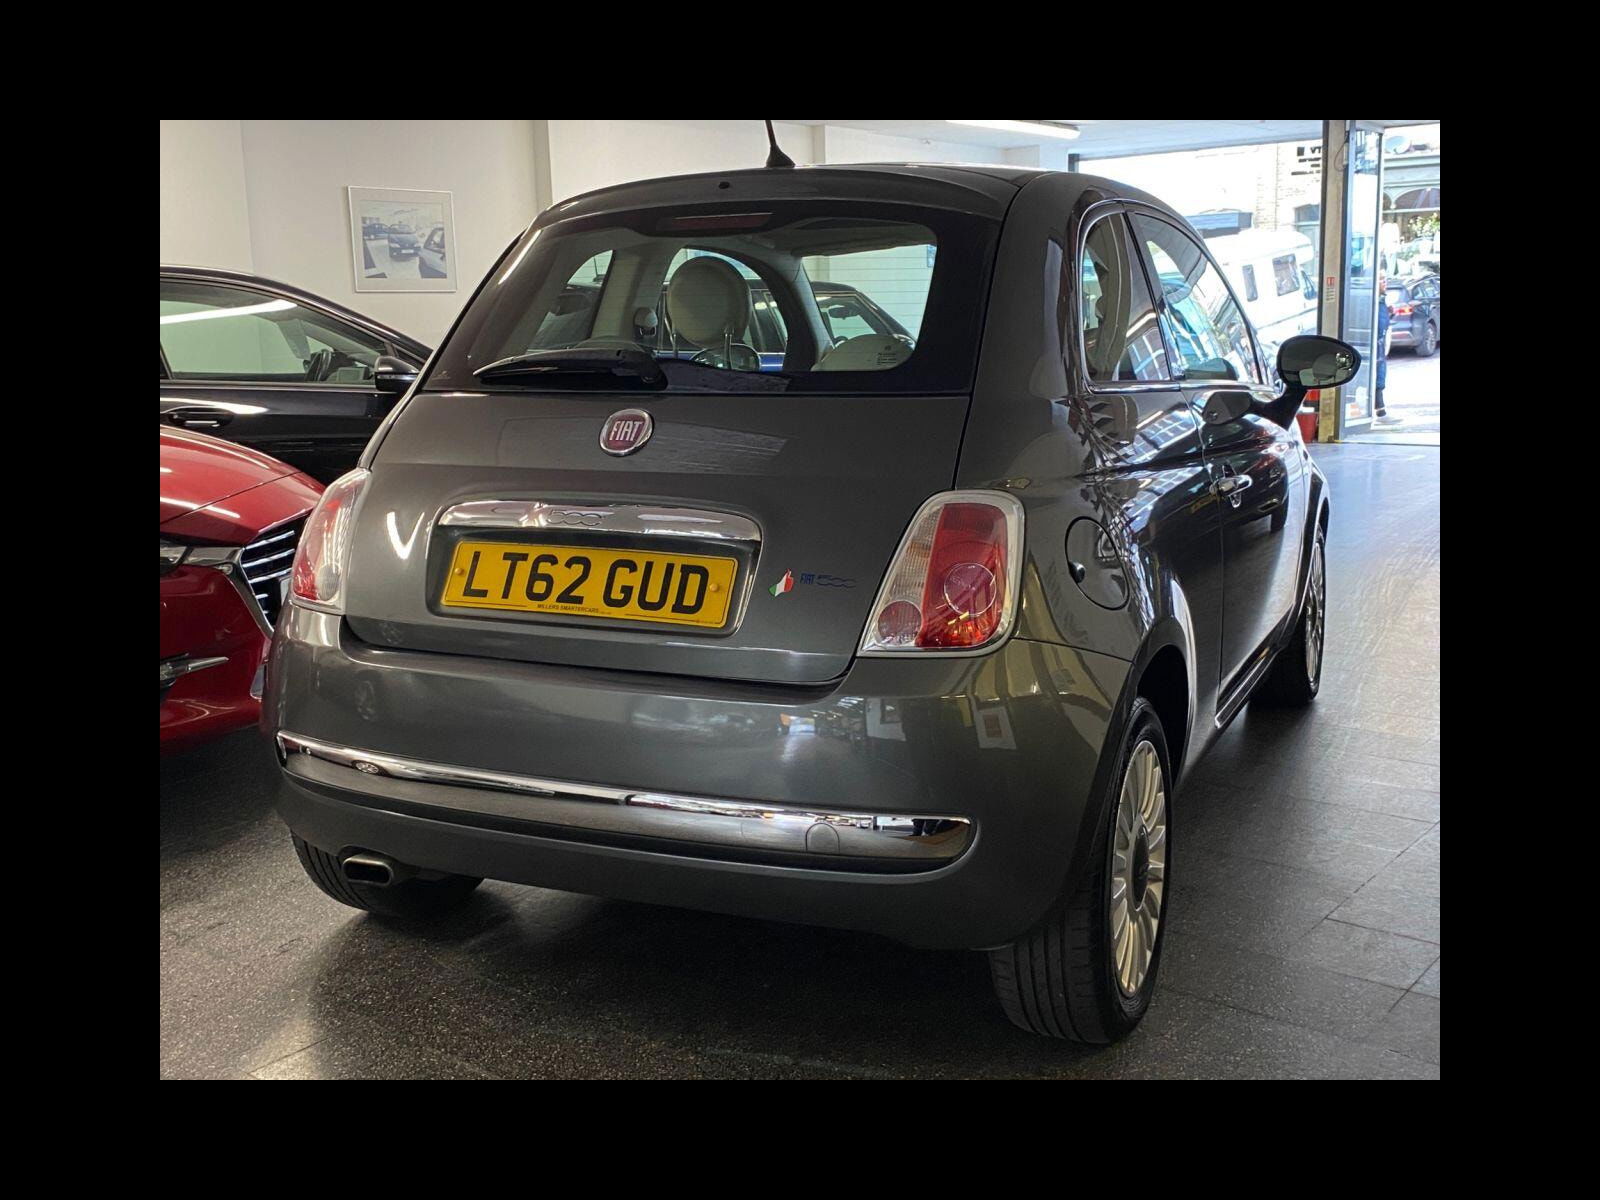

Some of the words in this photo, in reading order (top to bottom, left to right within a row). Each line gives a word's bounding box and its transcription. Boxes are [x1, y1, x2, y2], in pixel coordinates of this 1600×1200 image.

[609, 420, 642, 441] FIAT
[462, 551, 591, 604] LT62
[603, 559, 709, 614] GUD
[800, 572, 815, 585] FIAT
[815, 574, 857, 589] 500
